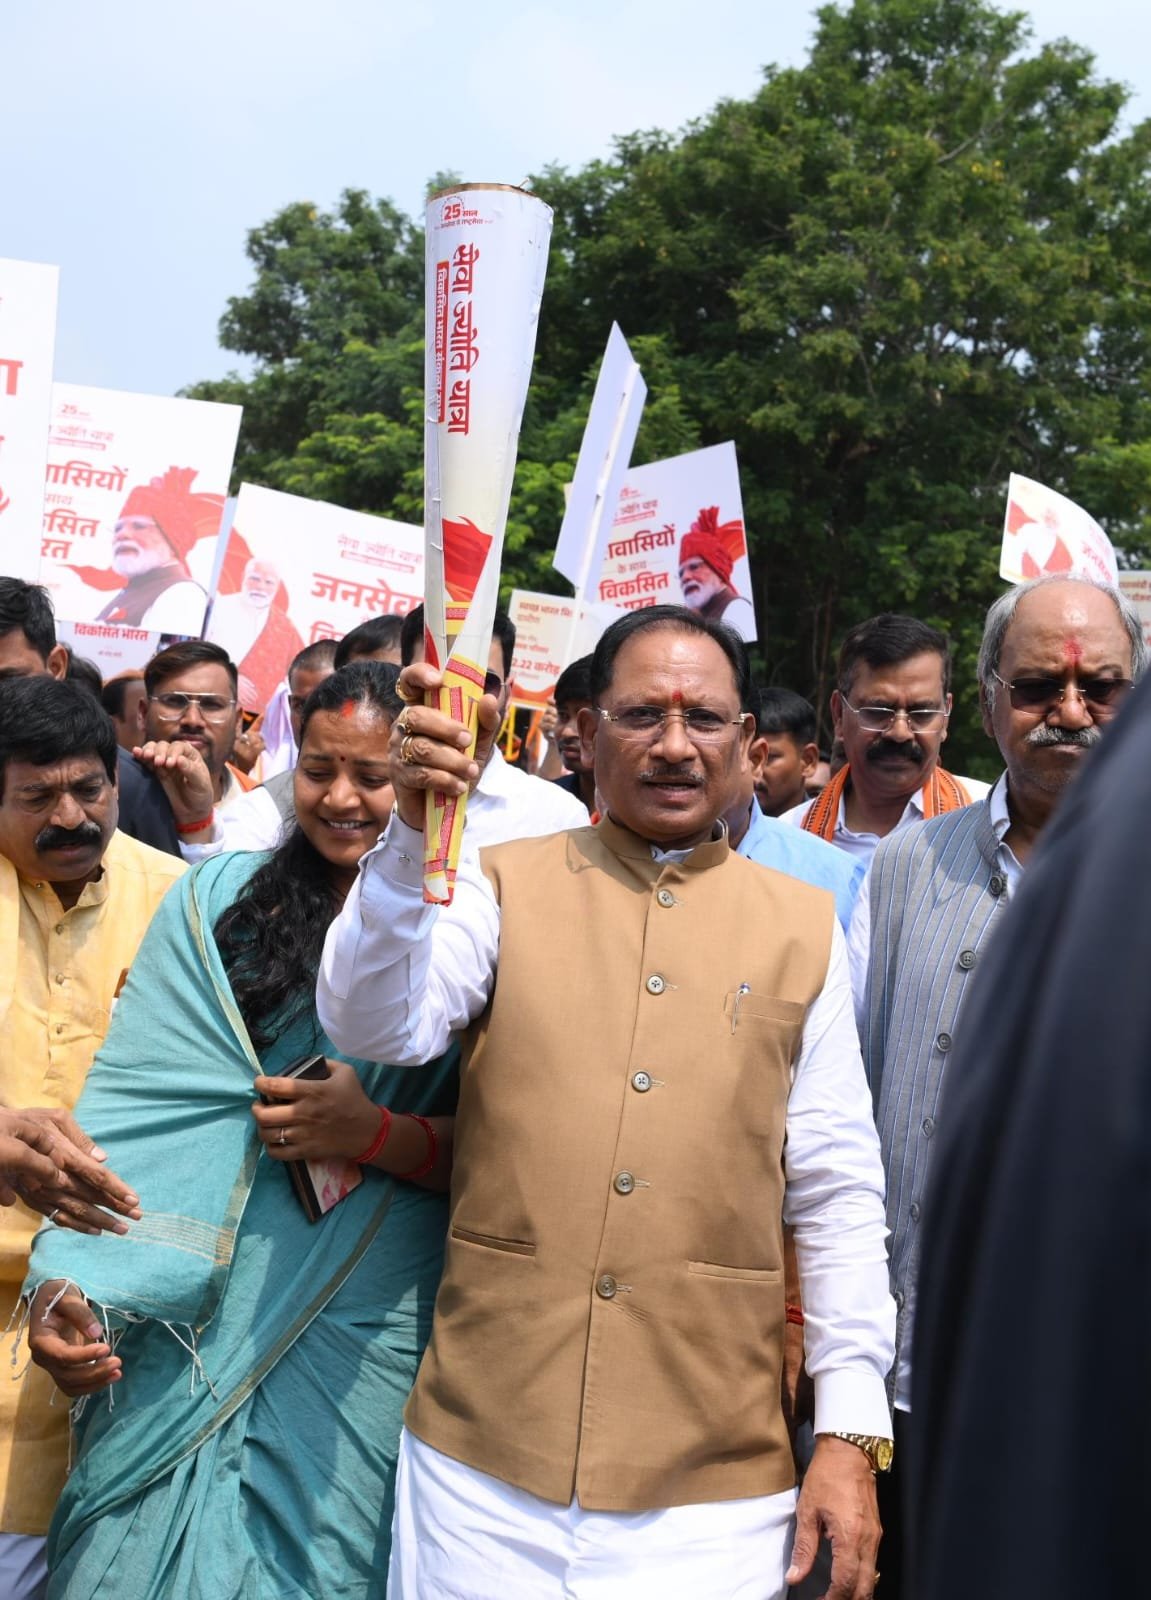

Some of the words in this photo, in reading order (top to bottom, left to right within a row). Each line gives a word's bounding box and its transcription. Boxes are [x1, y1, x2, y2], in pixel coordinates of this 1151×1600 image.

[444, 203, 461, 220] 25
[452, 242, 480, 294] सेवा
[450, 301, 480, 373] ज्योति
[448, 379, 471, 436] यात्रा
[46, 460, 129, 492] ासियों
[43, 508, 101, 538] सित
[40, 538, 73, 560] रत
[607, 524, 676, 561] वासियों
[311, 572, 425, 616] जनसेव
[599, 570, 670, 602] विकसित
